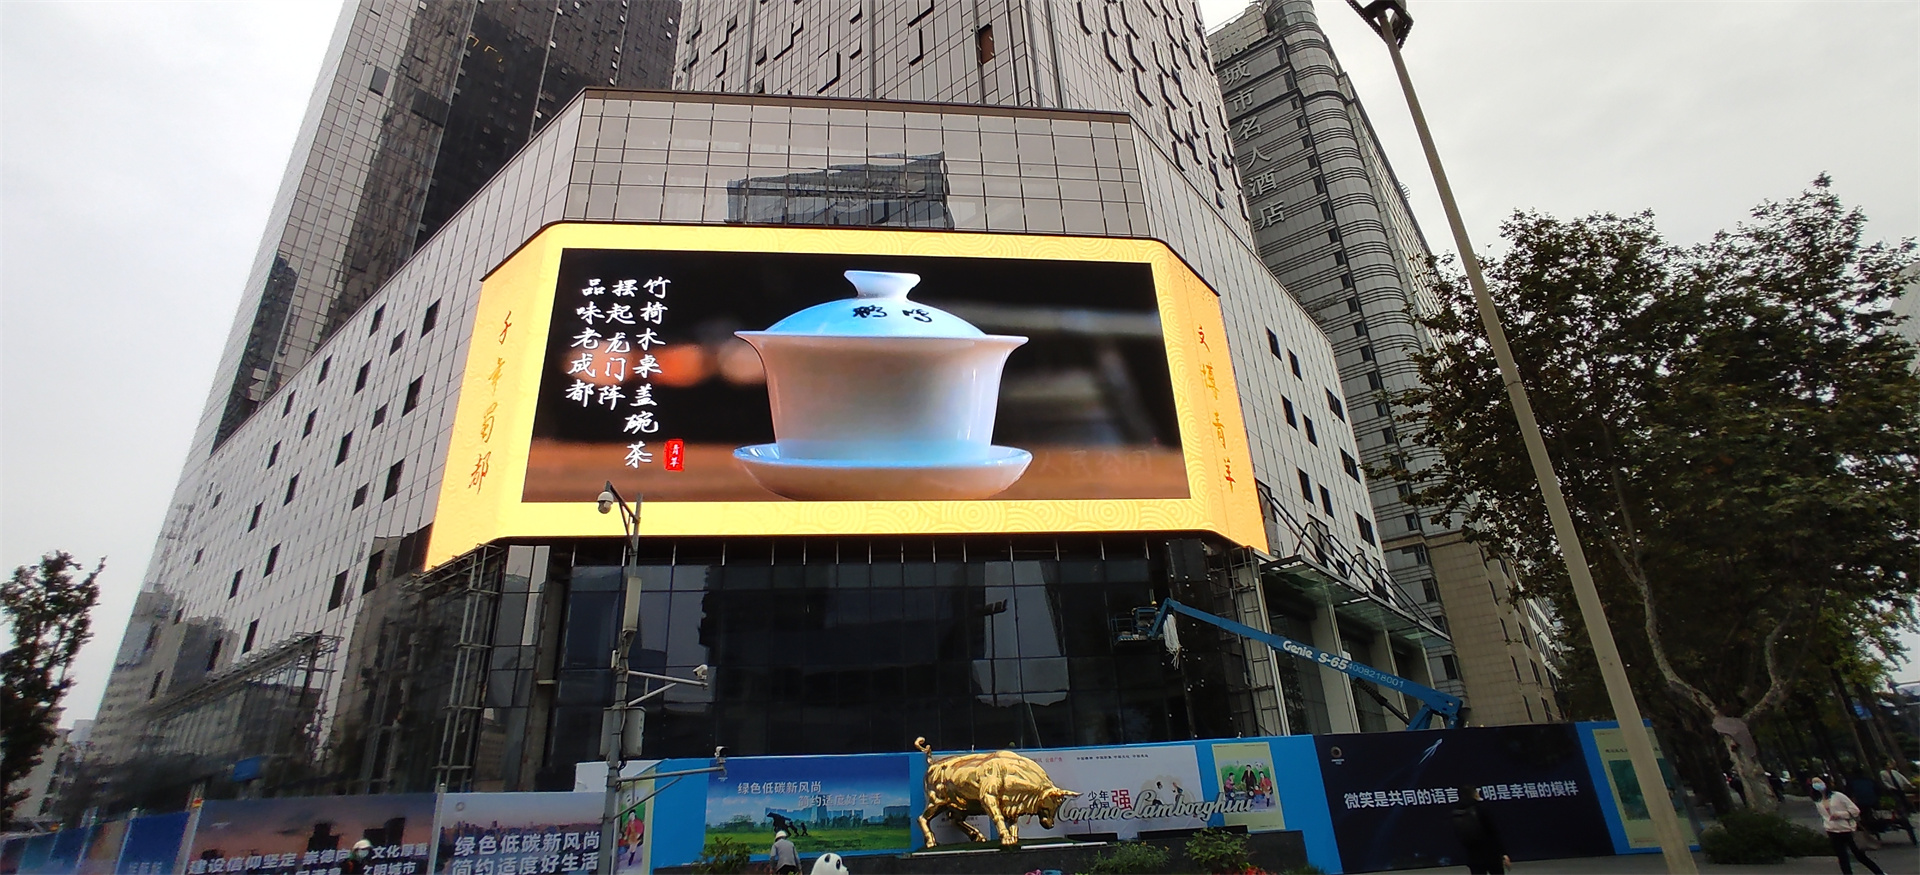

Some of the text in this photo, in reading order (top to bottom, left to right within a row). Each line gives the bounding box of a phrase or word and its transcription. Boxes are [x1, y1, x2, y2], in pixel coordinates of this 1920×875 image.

[1222, 60, 1286, 231] 城市名人酒店
[565, 278, 607, 408] 品味老成都
[597, 279, 639, 411] 摆起龙门阵
[623, 276, 672, 469] 竹椅木桌盖碗茶
[1282, 640, 1405, 689] Genie S-65 4008218001
[737, 780, 822, 795] 绿色低碳新风尚
[798, 793, 882, 808] 简约适度好生活
[1087, 789, 1110, 802] 少年
[1343, 786, 1460, 809] 微笑是共同的语言
[1121, 789, 1253, 822] Lamborghini
[189, 851, 298, 875] 建设信仰坚定
[371, 842, 428, 860] 文化厚重
[453, 831, 600, 857] 绿色低碳新风尚
[451, 852, 599, 875] 简约适度好生活
